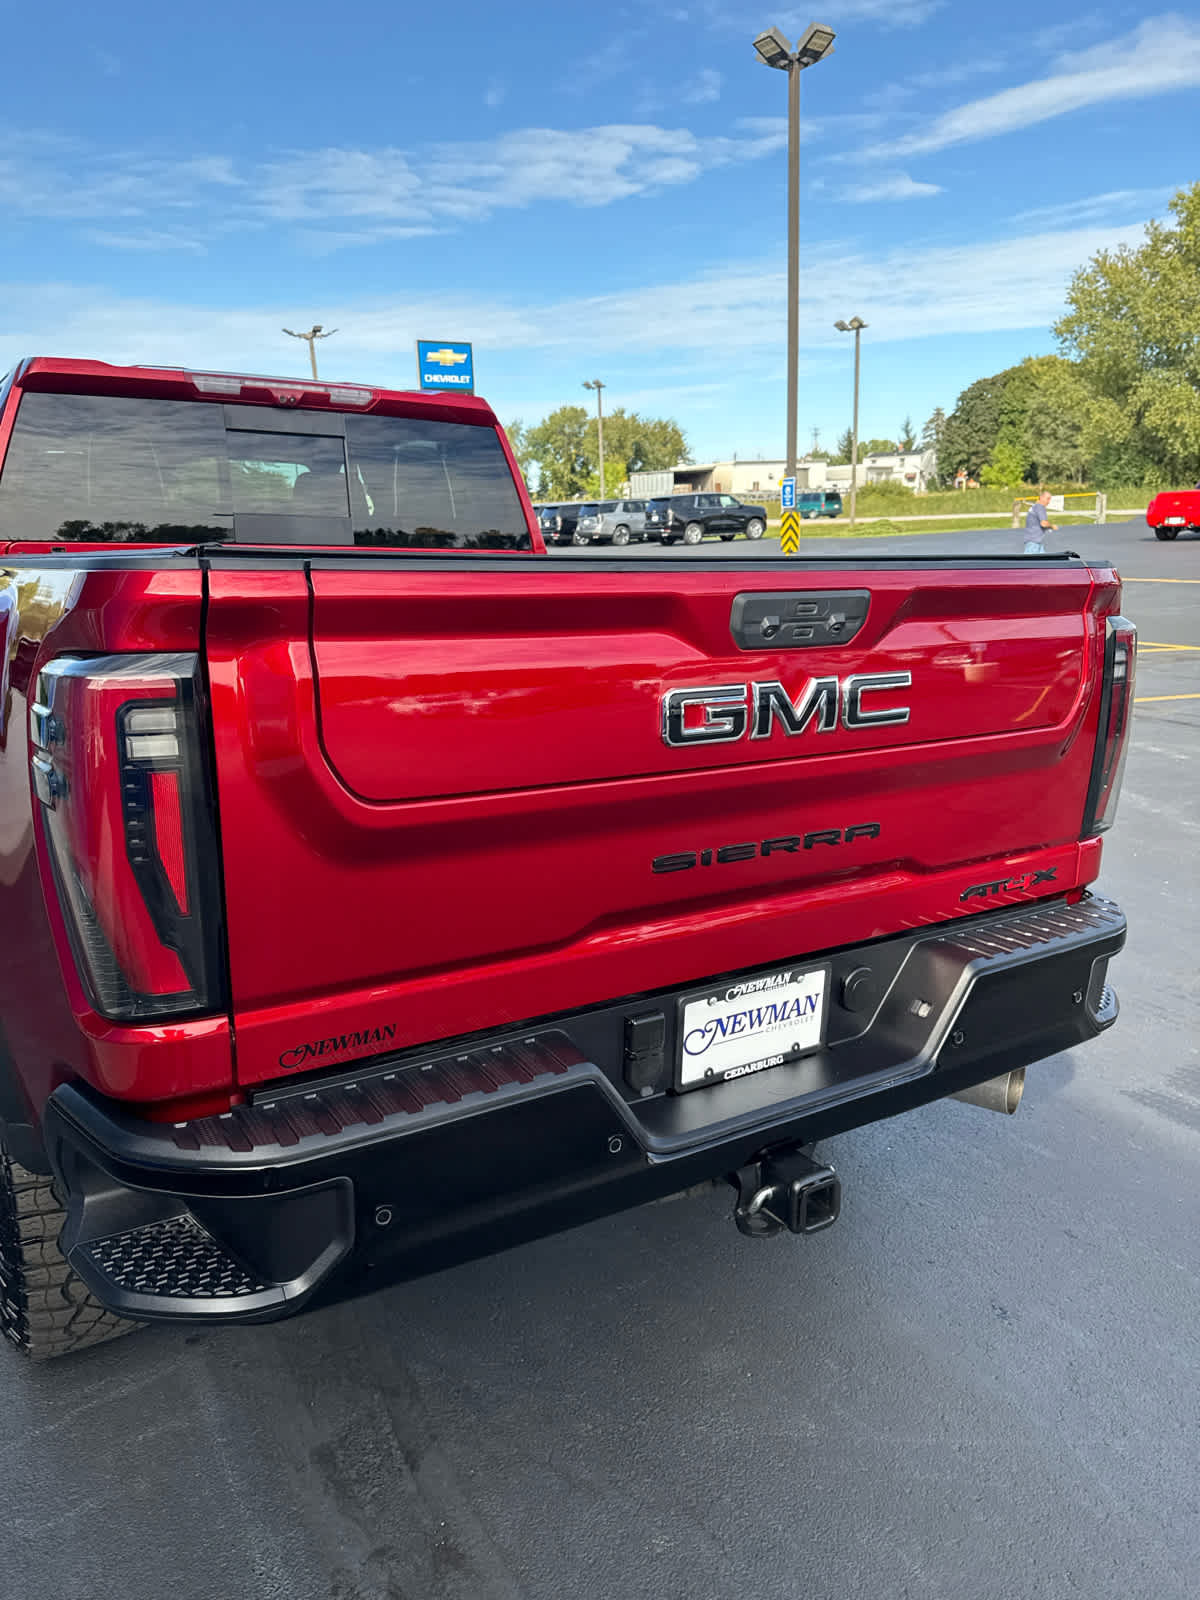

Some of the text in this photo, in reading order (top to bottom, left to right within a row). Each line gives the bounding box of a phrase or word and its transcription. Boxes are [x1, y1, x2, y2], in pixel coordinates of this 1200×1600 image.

[424, 374, 471, 384] CHEVROLET
[661, 670, 913, 748] GMC
[651, 821, 881, 874] SIERRA
[959, 866, 1058, 902] AT4X
[725, 972, 793, 1002] NEWMAN
[684, 993, 821, 1056] NEWMAN
[765, 1015, 815, 1033] CHEVROLET
[279, 1023, 397, 1068] NEWMAN
[723, 1054, 784, 1080] CEDARBURG
